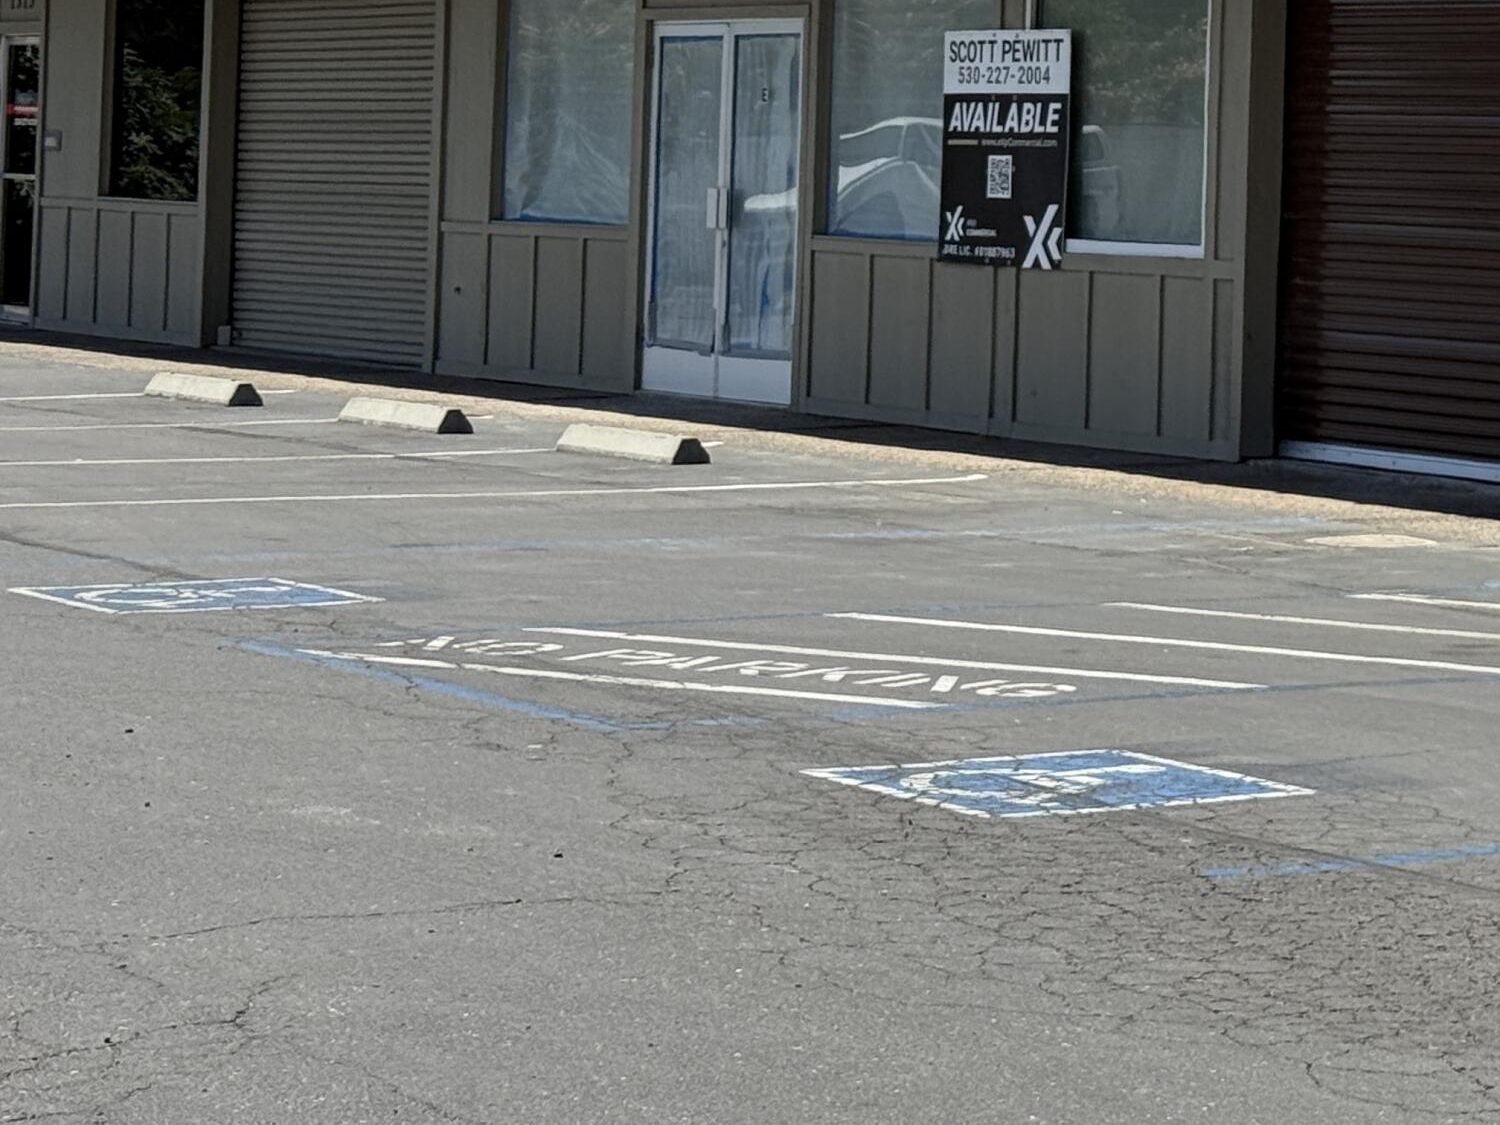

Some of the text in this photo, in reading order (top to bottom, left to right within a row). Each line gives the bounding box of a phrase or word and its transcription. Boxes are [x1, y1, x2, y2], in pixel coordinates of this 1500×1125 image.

[949, 38, 1064, 64] SCOTT PEWITT
[958, 66, 1051, 85] 530-227-2004
[948, 101, 1062, 133] AVAILABLE
[561, 649, 1078, 698] PARKING
